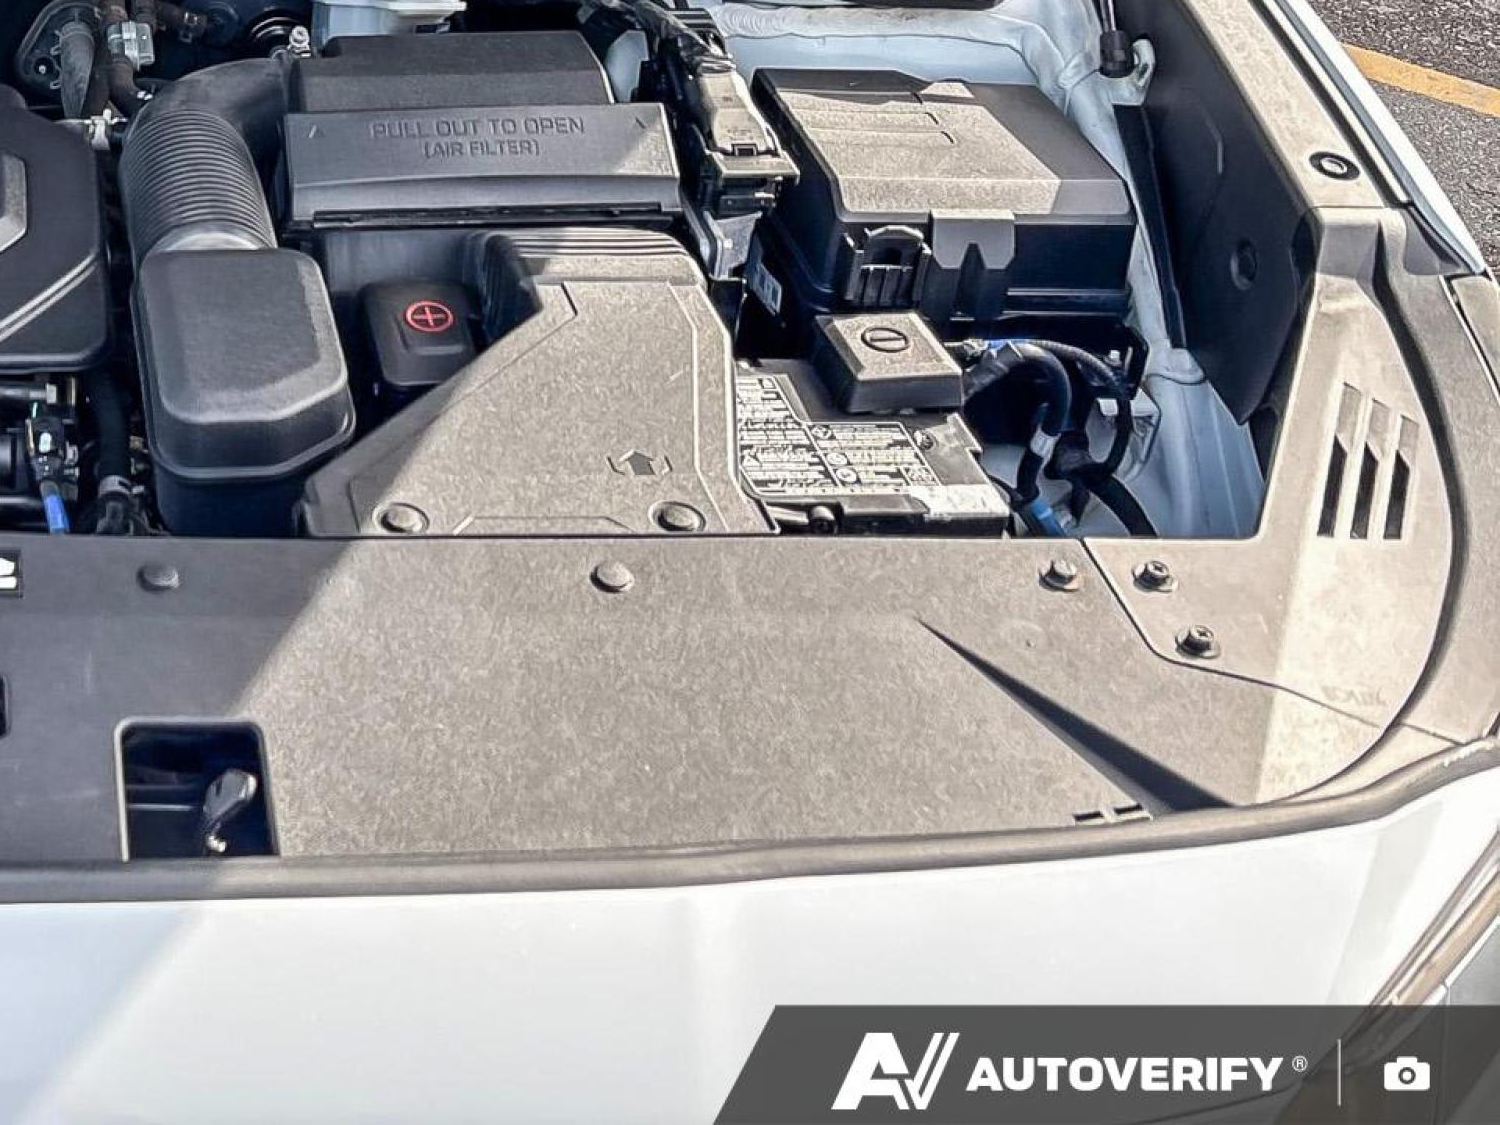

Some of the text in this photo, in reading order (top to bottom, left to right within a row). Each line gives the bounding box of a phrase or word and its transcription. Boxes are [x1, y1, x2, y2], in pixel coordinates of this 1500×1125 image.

[371, 117, 585, 139] PULL OUT TO OPEN
[424, 138, 540, 158] (AIR FILTER)
